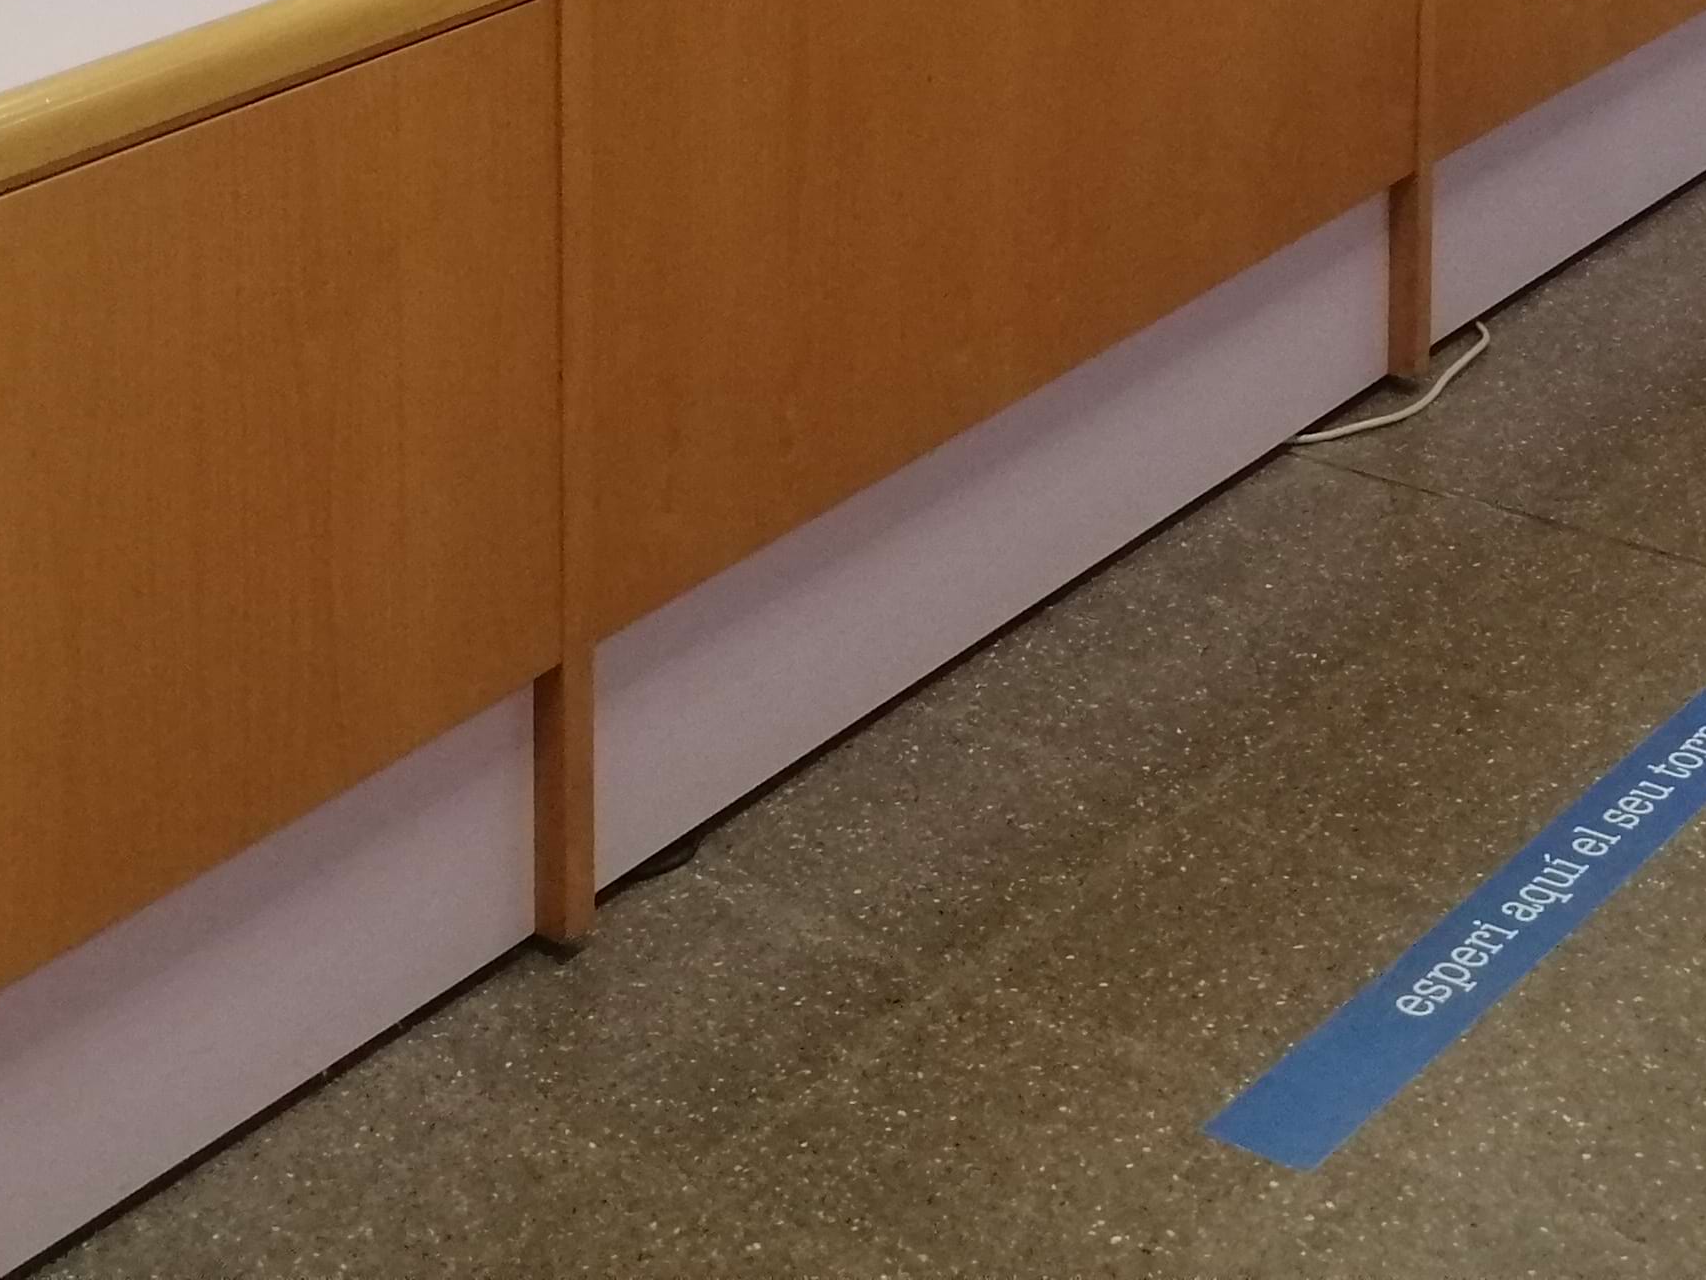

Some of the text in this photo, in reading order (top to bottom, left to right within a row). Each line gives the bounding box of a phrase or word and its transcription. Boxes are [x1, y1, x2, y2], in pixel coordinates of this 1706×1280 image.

[1395, 919, 1519, 1017] esperi
[1501, 853, 1589, 923] aquí
[1572, 826, 1621, 857] el
[1603, 780, 1674, 830] seu
